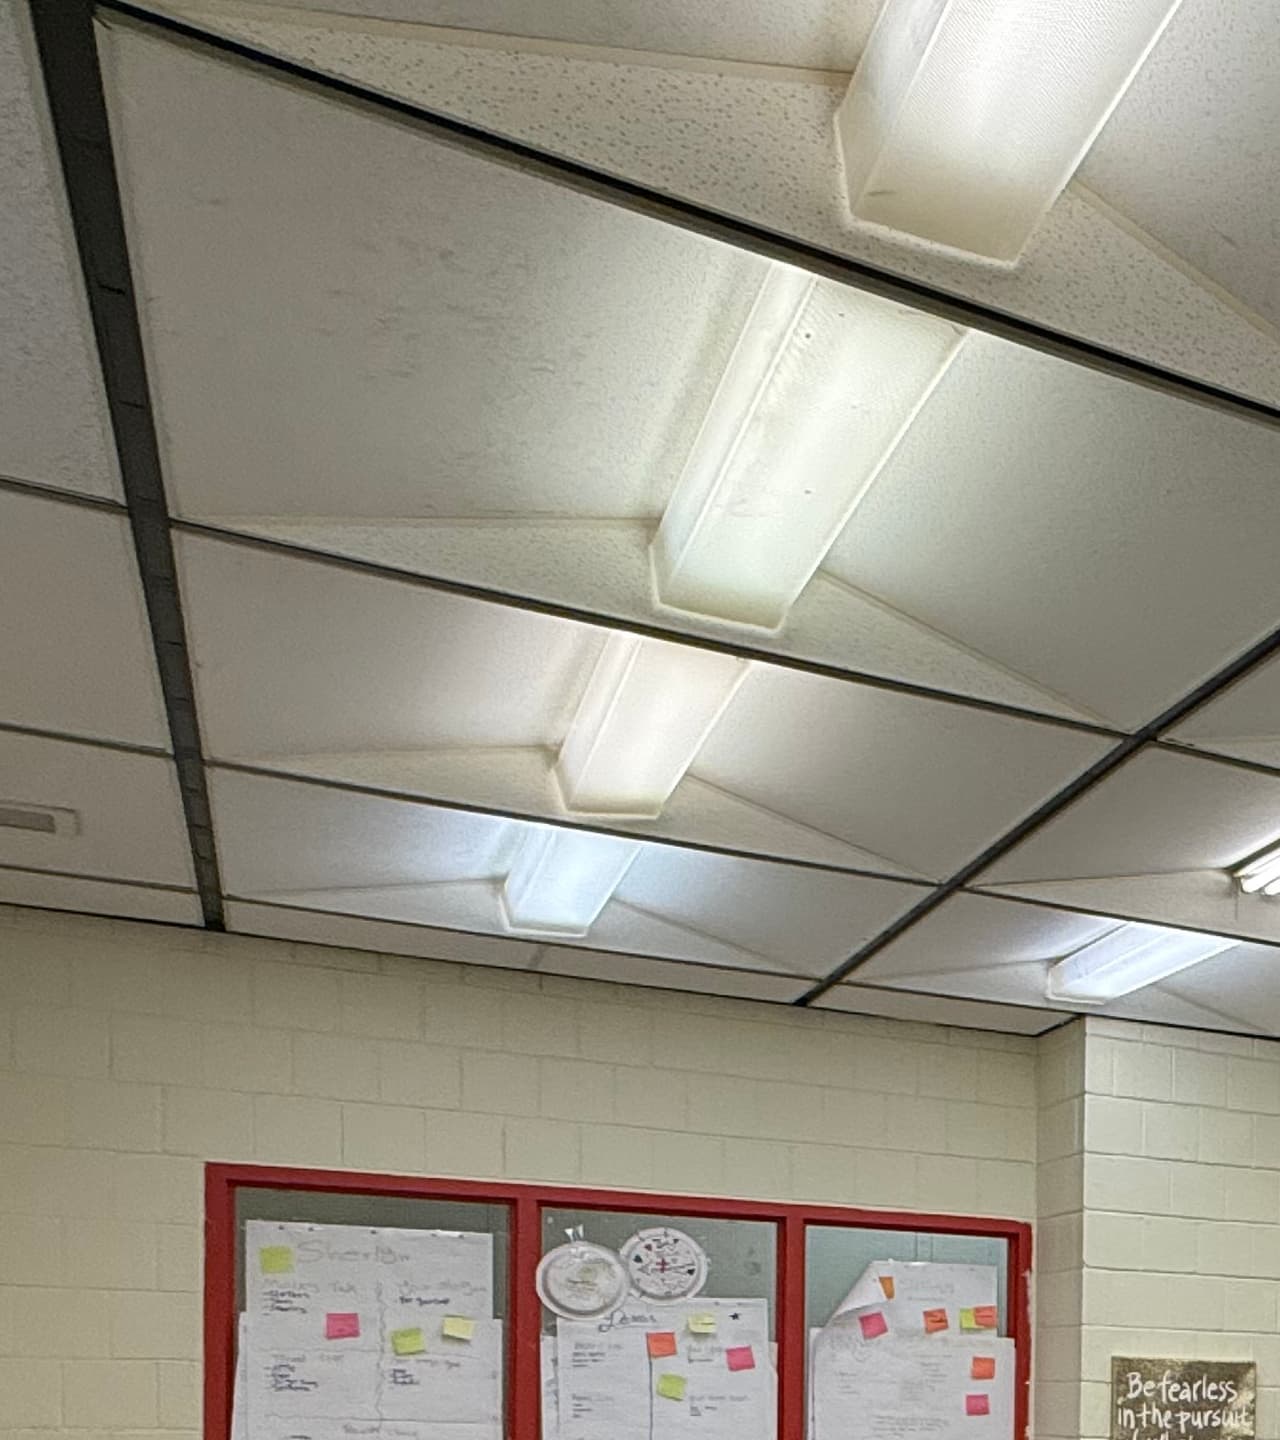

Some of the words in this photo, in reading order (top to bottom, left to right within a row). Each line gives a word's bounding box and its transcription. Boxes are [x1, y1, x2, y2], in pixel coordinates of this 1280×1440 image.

[1127, 1371, 1156, 1399] Be
[1156, 1369, 1238, 1404] fearless
[1117, 1407, 1136, 1429] in
[1136, 1402, 1173, 1429] the
[1174, 1407, 1253, 1434] pursuit
